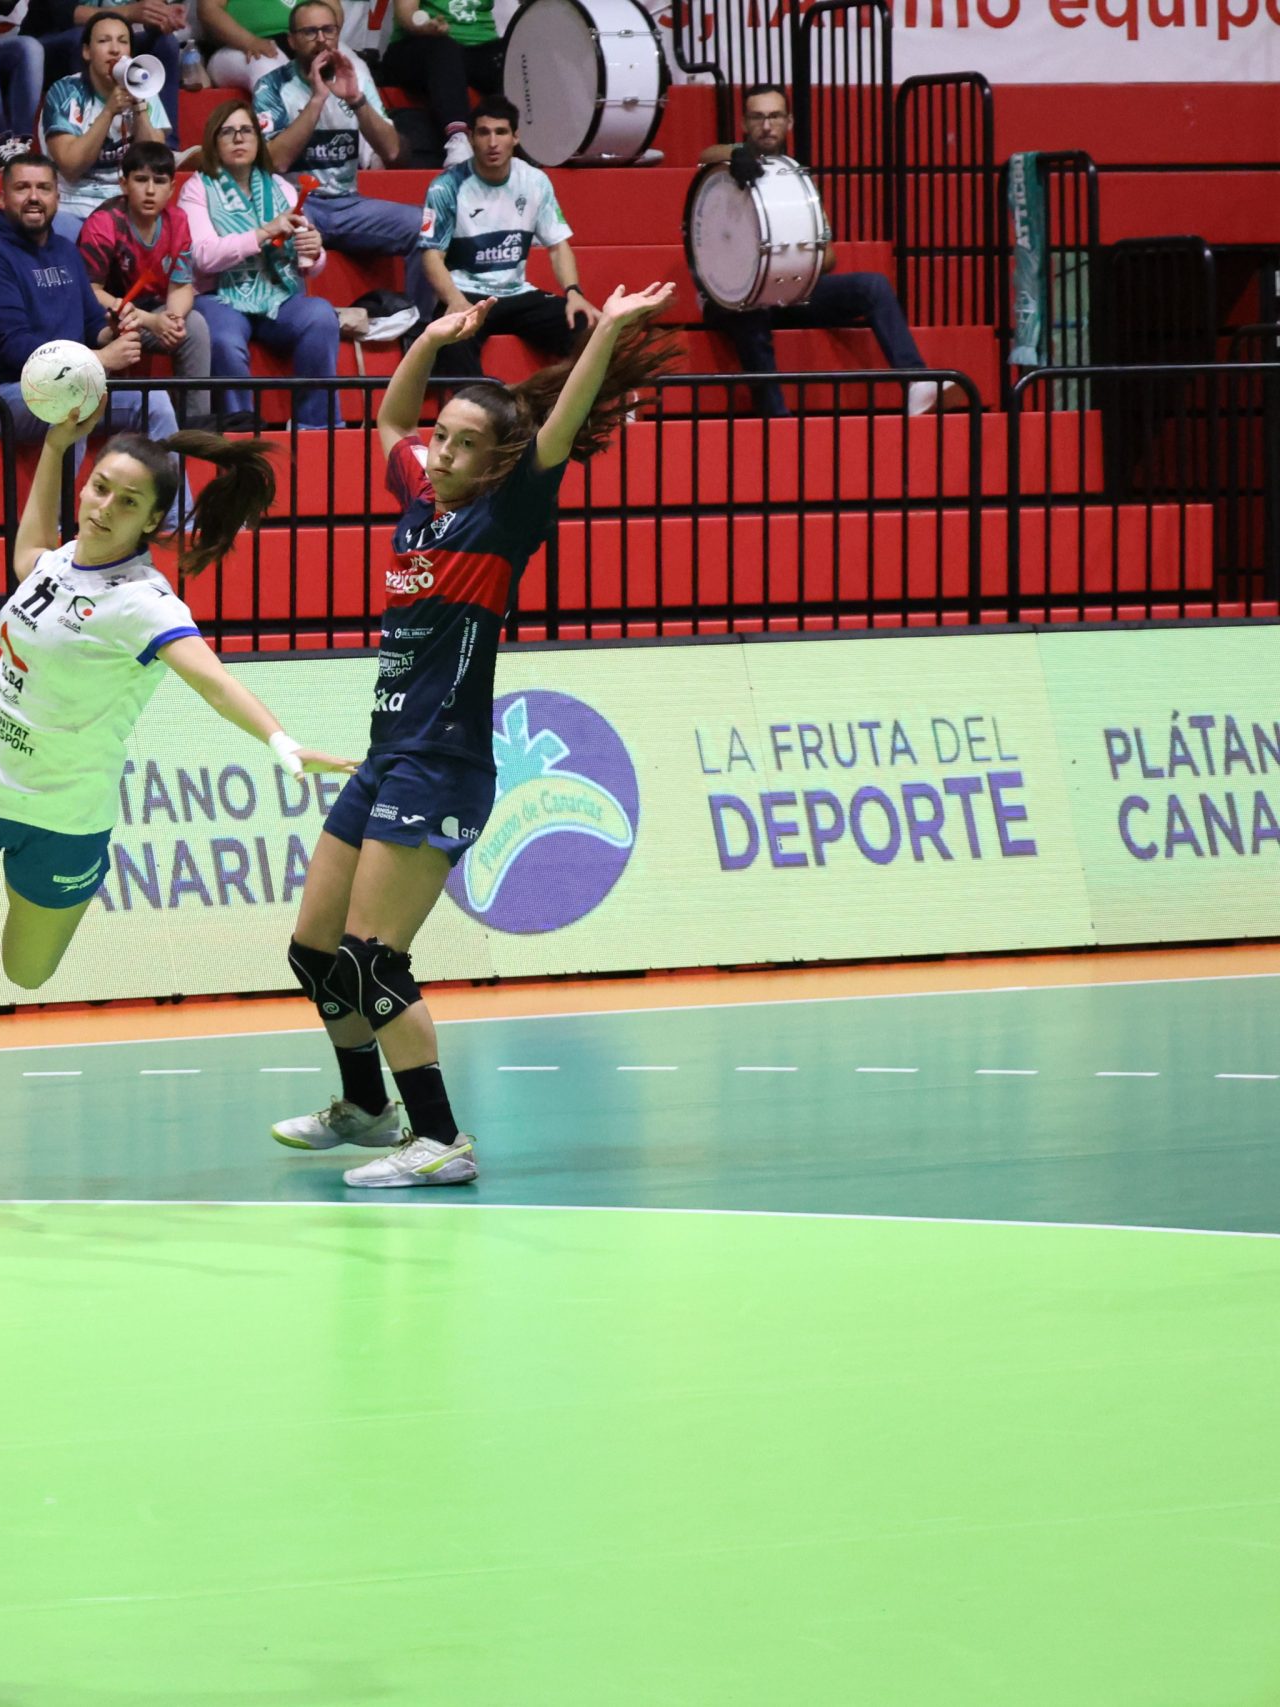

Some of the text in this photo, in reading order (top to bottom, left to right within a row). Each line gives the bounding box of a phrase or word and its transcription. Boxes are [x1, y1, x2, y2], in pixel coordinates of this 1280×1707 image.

[475, 244, 522, 261] atticg
[9, 604, 38, 632] network
[695, 716, 1019, 774] LA FRUTA DEL
[1103, 709, 1280, 781] PLÁTAN
[120, 760, 341, 826] TANO DE
[708, 770, 1038, 872] DEPORTE
[1118, 790, 1280, 862] CANA
[94, 834, 312, 911] NARIA
